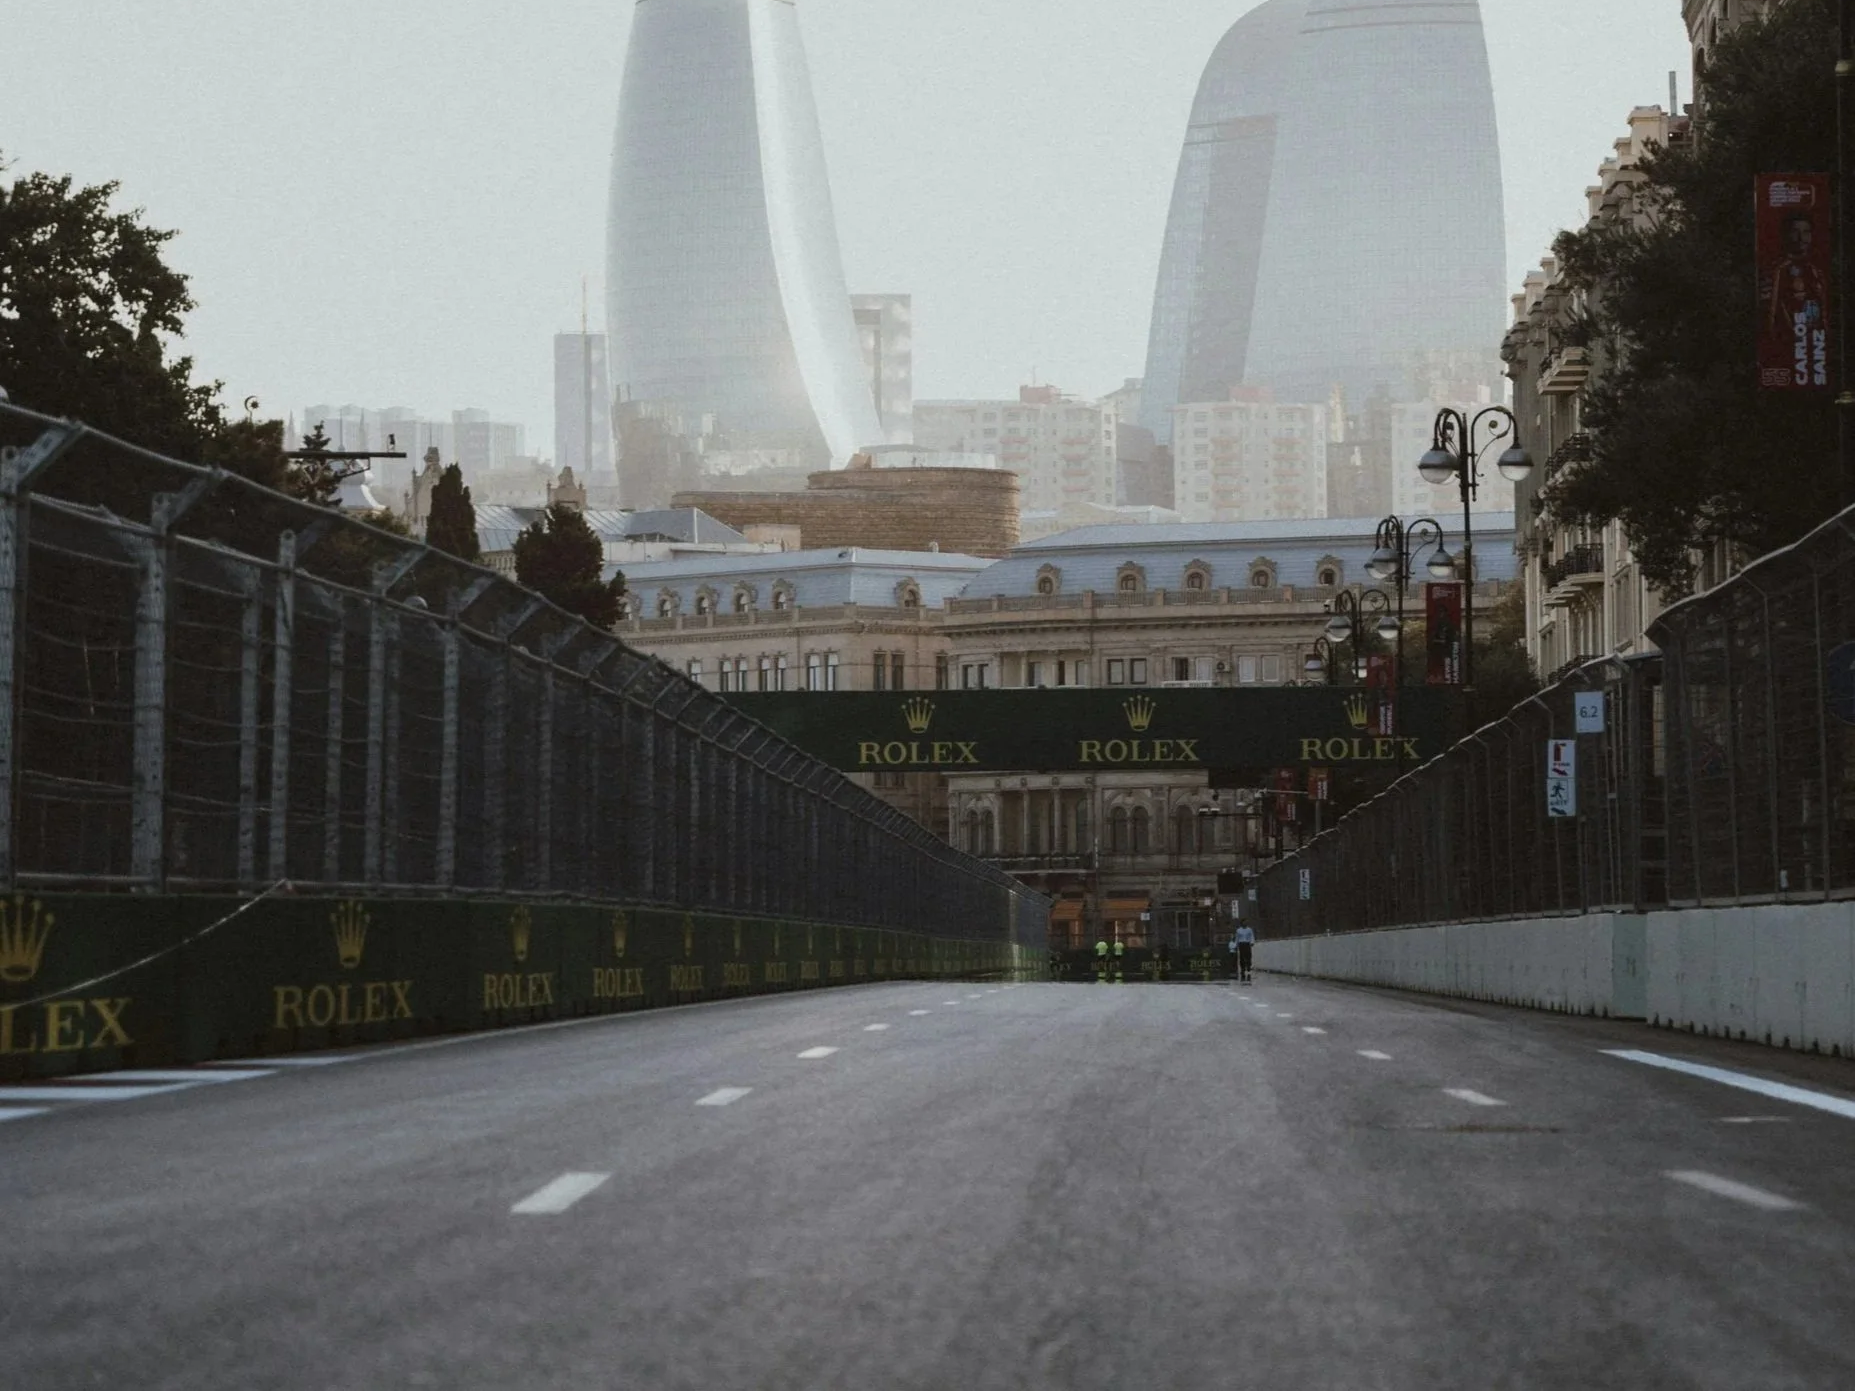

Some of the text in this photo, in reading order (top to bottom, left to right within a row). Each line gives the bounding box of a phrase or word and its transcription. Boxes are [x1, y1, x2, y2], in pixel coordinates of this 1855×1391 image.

[1794, 312, 1808, 386] CARLOS
[1812, 329, 1827, 386] SAINZ
[1580, 706, 1599, 718] 6.2
[858, 741, 980, 764] ROLEX
[1078, 740, 1199, 762] ROLEX
[1299, 737, 1422, 760] ROLEX
[484, 972, 555, 1010] ROLEX
[592, 967, 645, 998] ROLEX
[274, 980, 414, 1029] ROLEX
